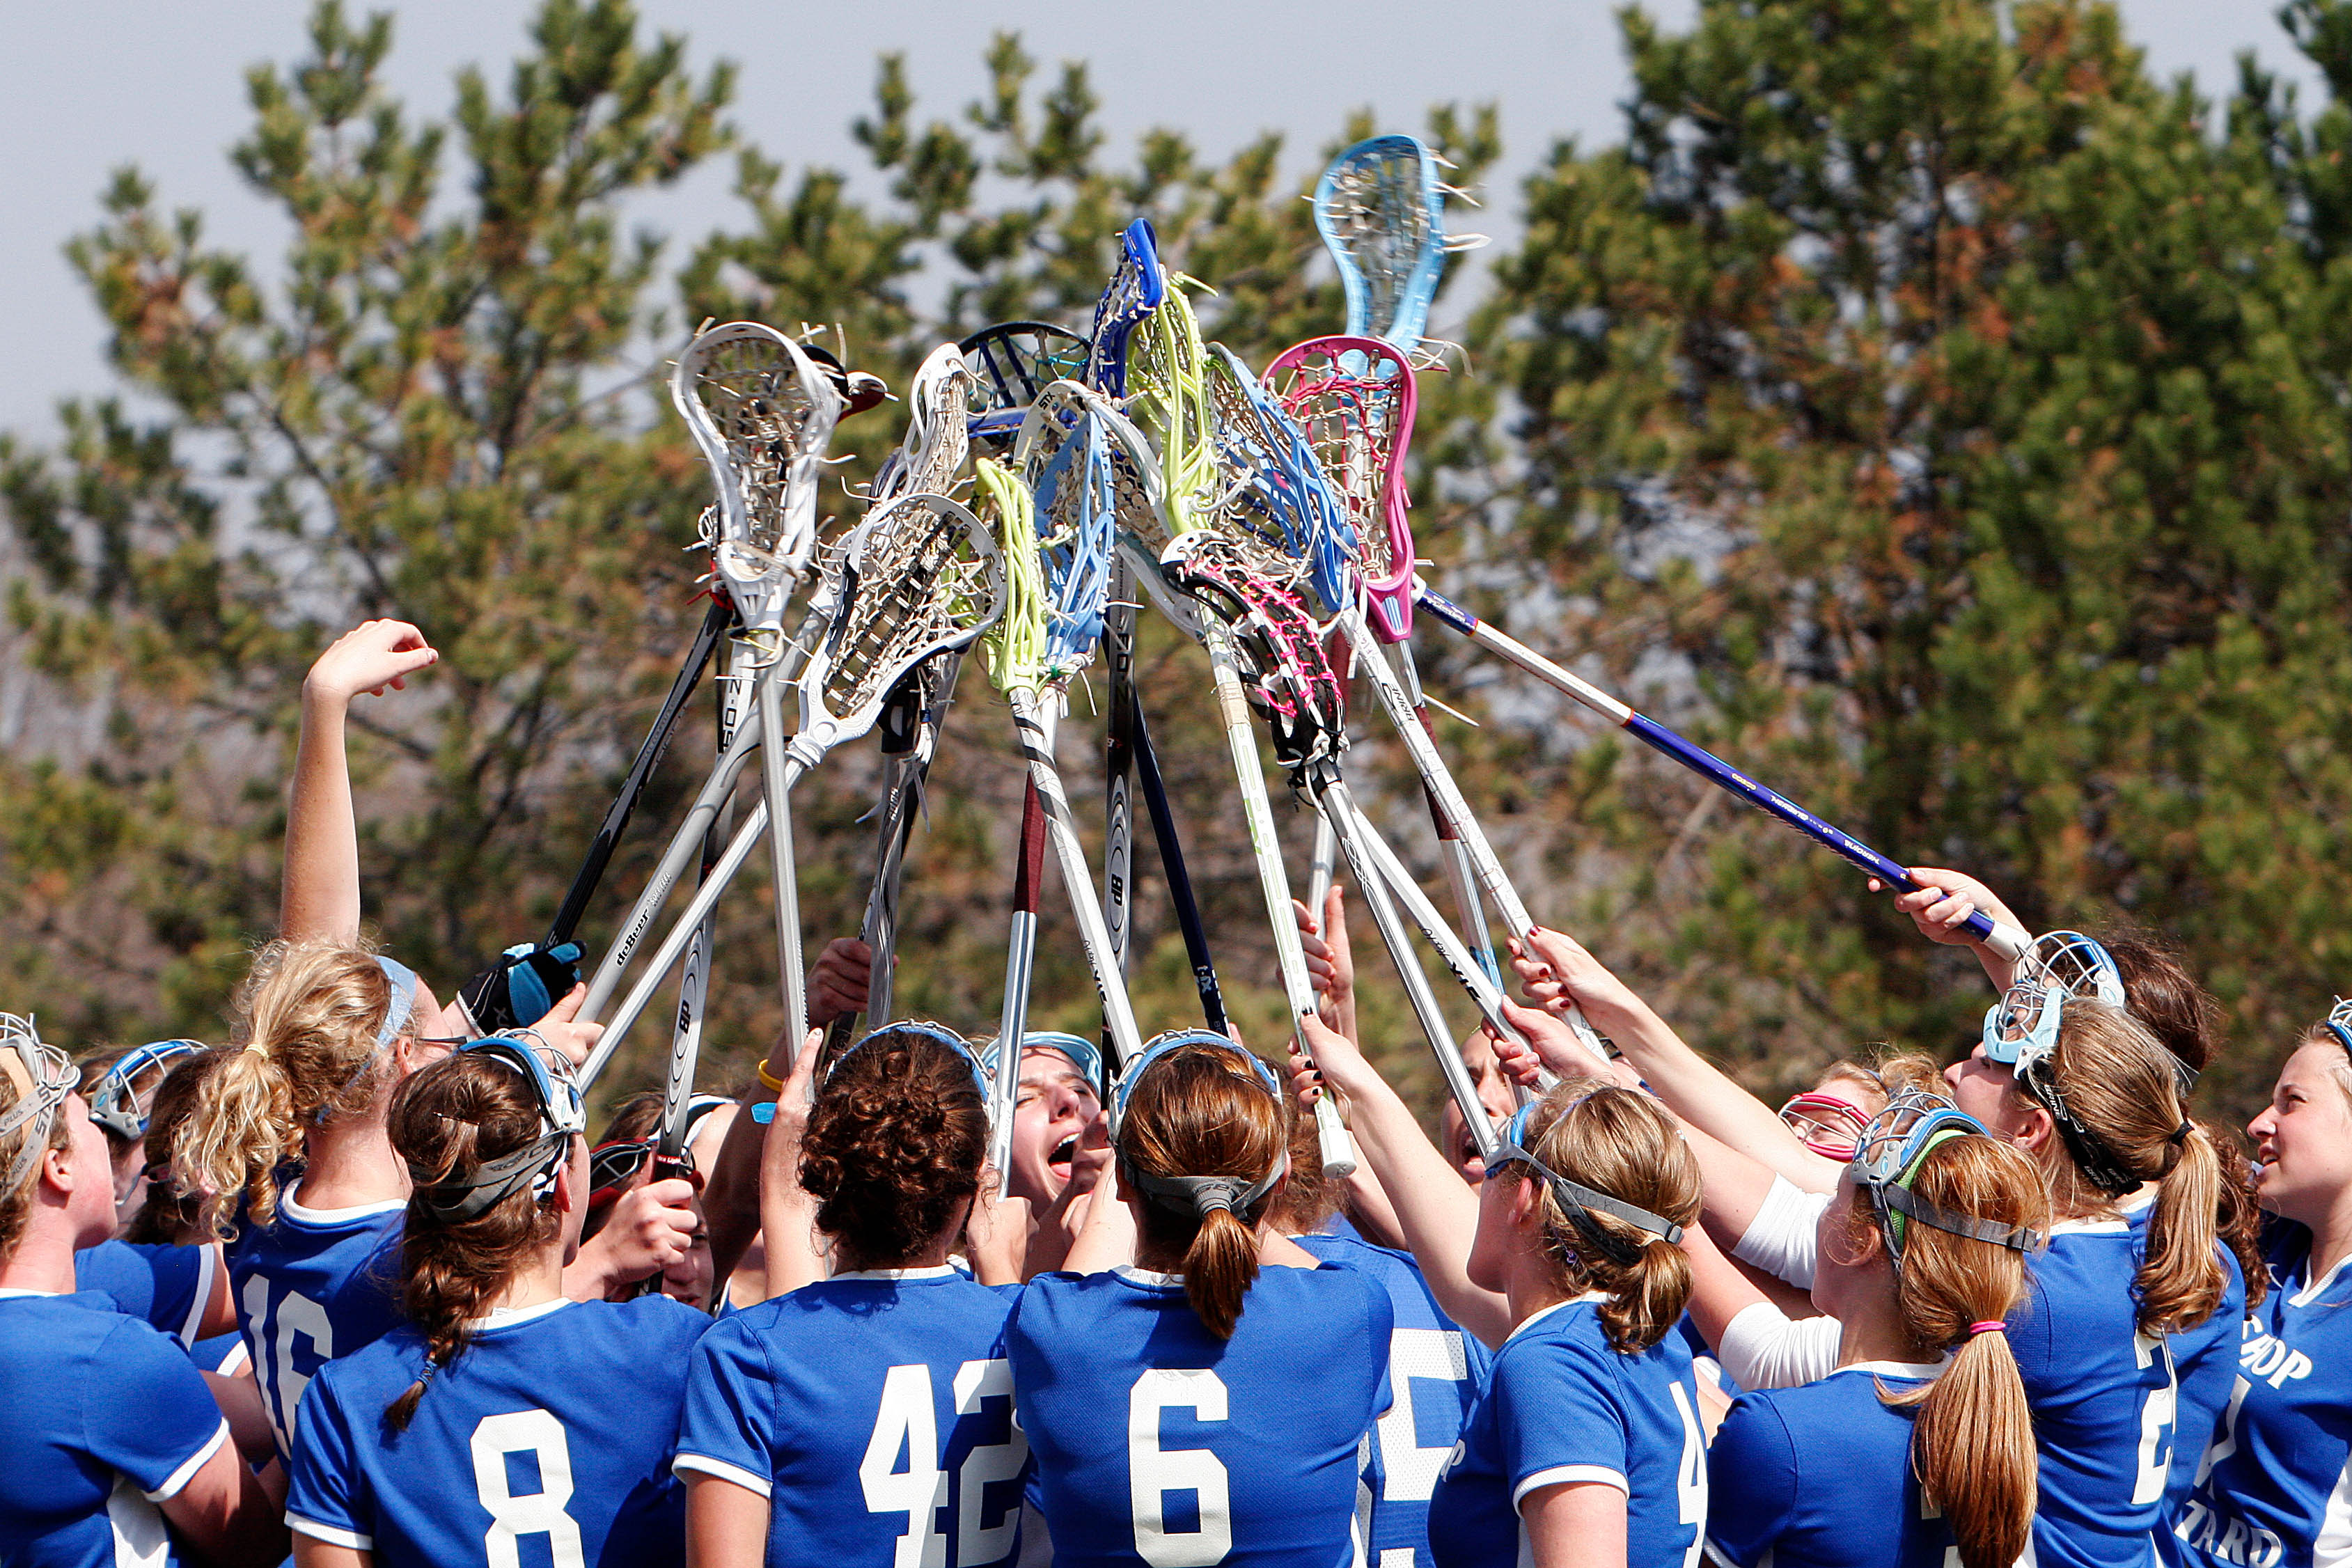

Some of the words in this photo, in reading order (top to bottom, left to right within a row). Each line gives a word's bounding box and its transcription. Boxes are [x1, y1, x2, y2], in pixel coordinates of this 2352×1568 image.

[1037, 391, 1056, 410] STX
[1389, 683, 1415, 722] BRINE
[614, 907, 650, 966] deBeer
[3, 1109, 24, 1126] PLUS
[243, 1273, 333, 1461] 16
[470, 1409, 586, 1568] 8
[859, 1358, 1028, 1568] 42
[1129, 1368, 1232, 1568] 6
